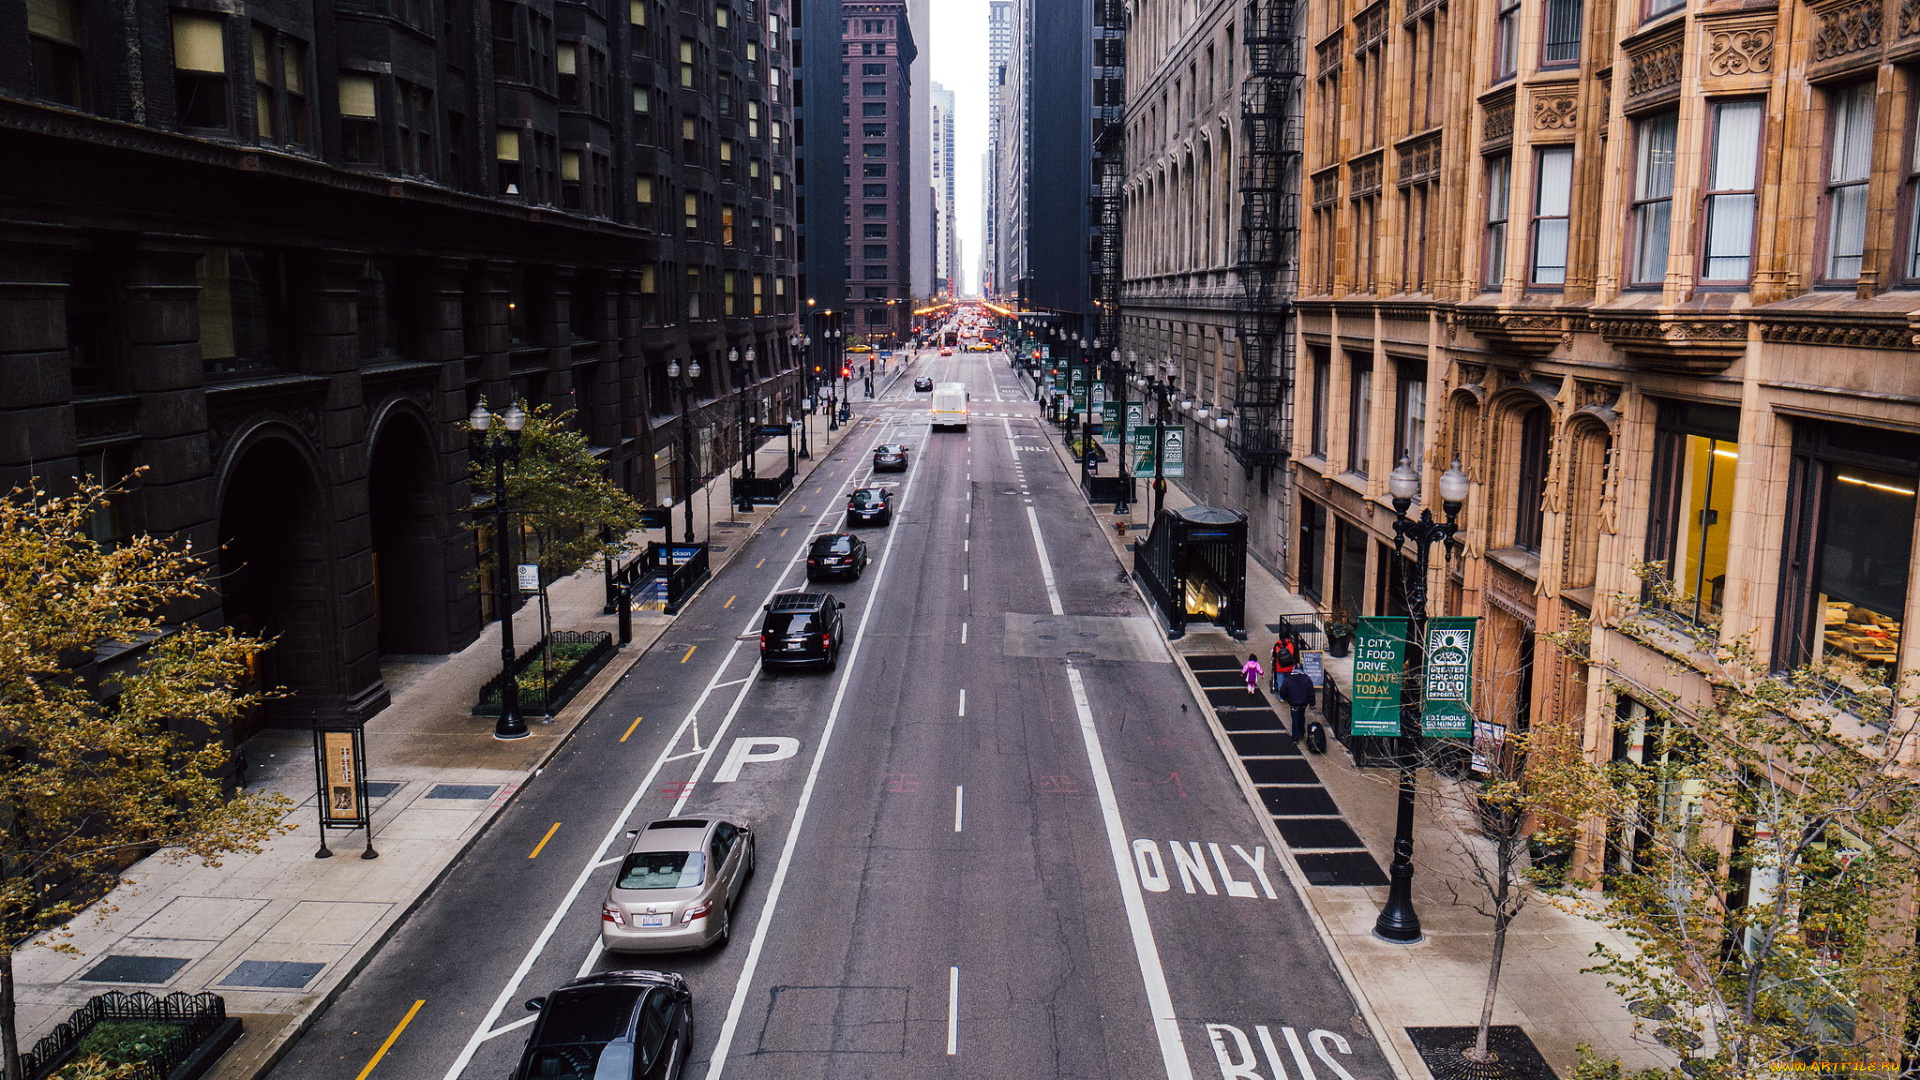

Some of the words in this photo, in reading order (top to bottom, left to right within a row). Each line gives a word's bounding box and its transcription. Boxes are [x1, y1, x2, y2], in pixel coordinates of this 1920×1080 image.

[1358, 637, 1364, 647] 1
[1367, 638, 1392, 649] CITY,
[1357, 648, 1363, 658] 1
[1366, 650, 1395, 660] FOOD
[1356, 661, 1389, 671] DRIVE.
[1356, 673, 1397, 683] DONATE
[1430, 673, 1465, 681] CHICAGO
[1355, 685, 1389, 695] TODAY.
[1429, 681, 1464, 691] FOOD
[712, 736, 800, 783] P
[1132, 838, 1279, 900] ONLY
[1205, 1023, 1356, 1080] BUS
